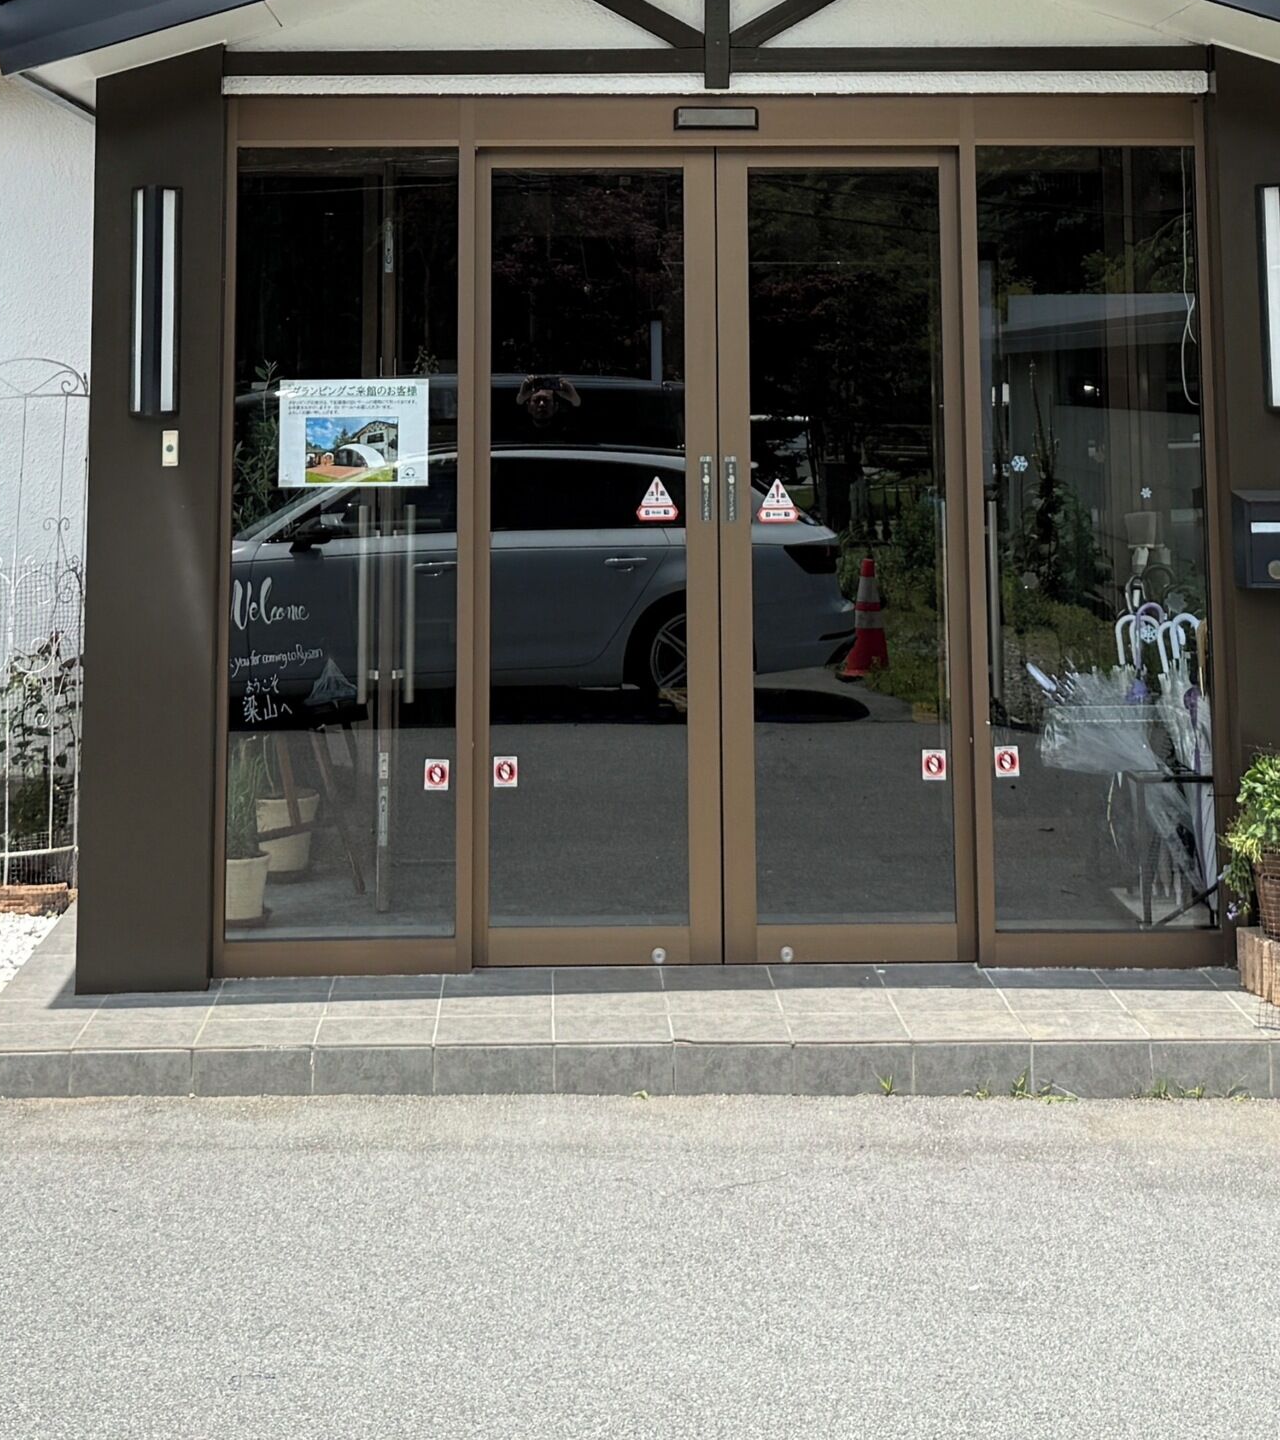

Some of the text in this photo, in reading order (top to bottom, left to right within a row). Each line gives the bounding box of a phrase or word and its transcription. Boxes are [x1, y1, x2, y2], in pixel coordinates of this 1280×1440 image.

[231, 657, 250, 678] you
[250, 649, 261, 666] for
[262, 653, 288, 669] coming
[287, 651, 297, 661] to
[246, 673, 280, 694] ようこそ
